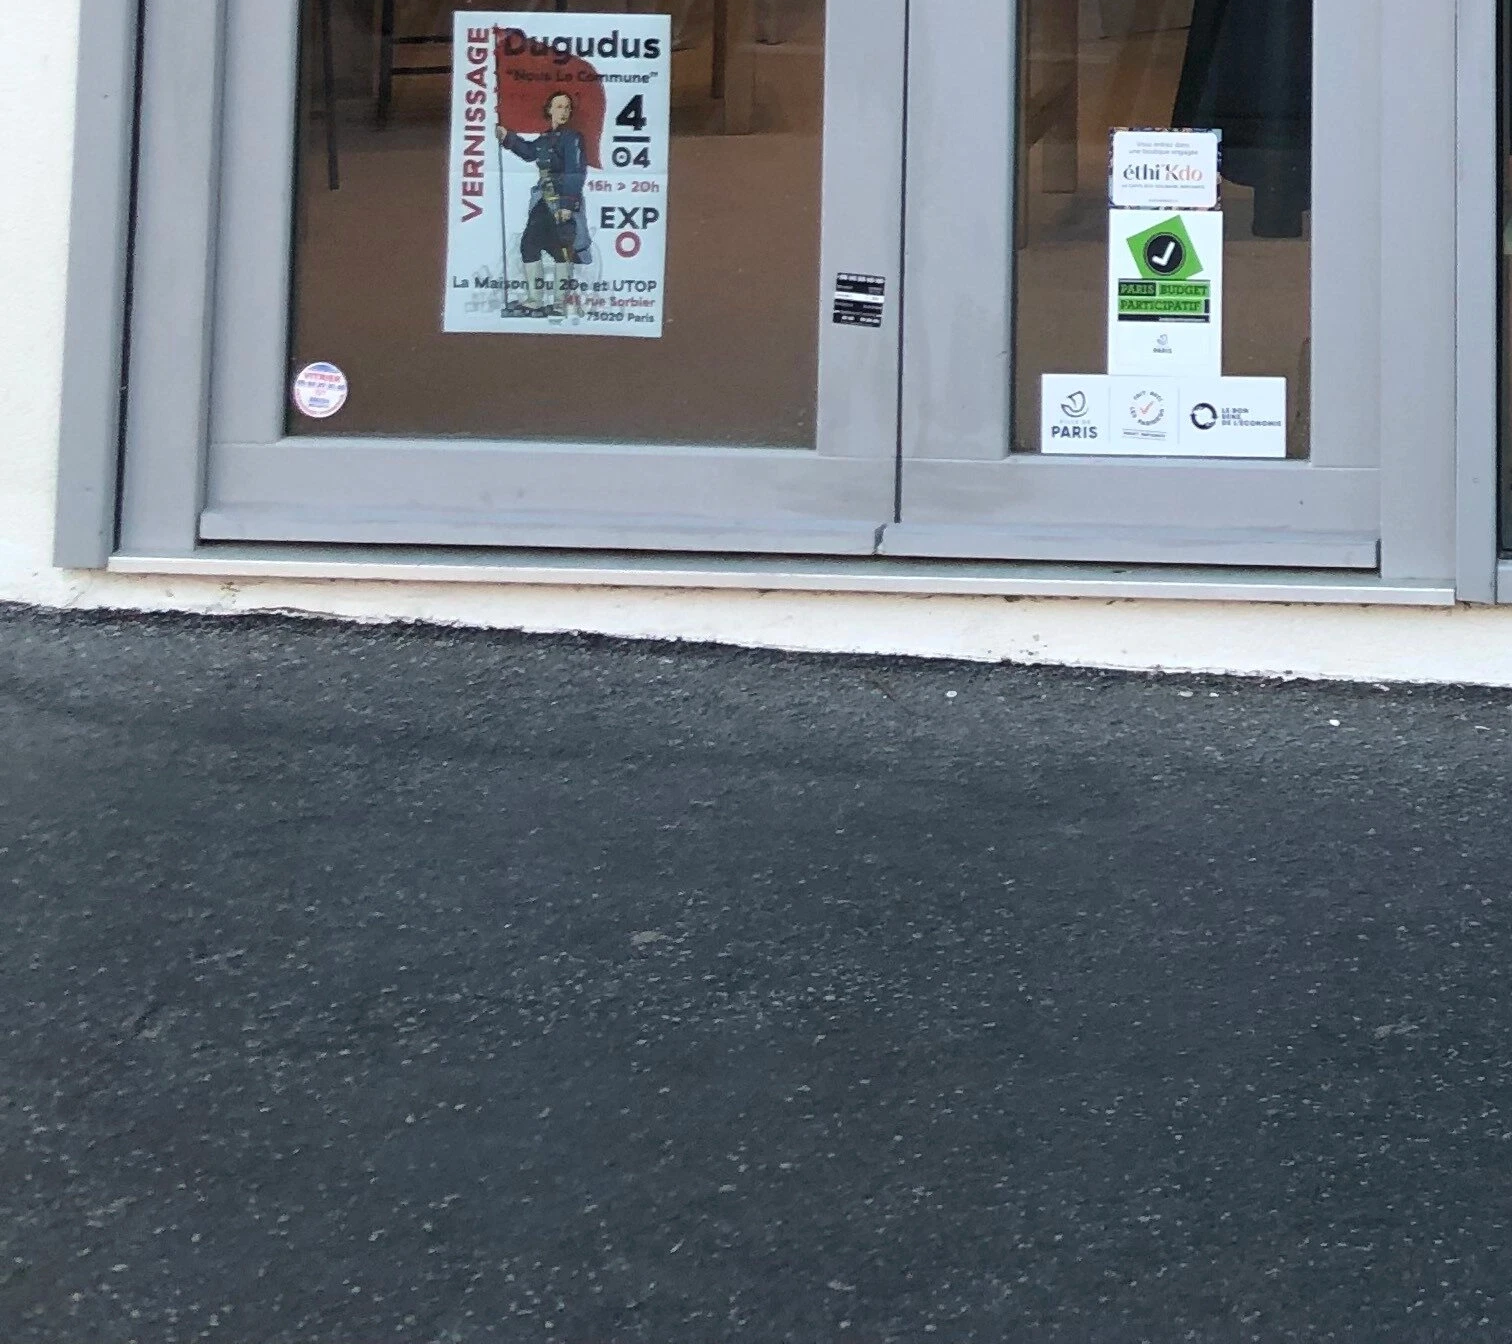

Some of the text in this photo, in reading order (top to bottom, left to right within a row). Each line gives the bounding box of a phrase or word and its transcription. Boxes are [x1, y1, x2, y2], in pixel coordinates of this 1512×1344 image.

[503, 28, 661, 65] Dugudus
[615, 94, 647, 131] 4
[461, 26, 490, 223] VERNISSAGE
[611, 146, 651, 168] 04
[630, 181, 660, 193] 20h
[600, 206, 660, 229] EXP
[453, 277, 469, 289] La
[475, 276, 529, 290] Maison
[534, 278, 554, 290] Du
[592, 280, 608, 291] et
[612, 279, 657, 292] UTOP
[1120, 283, 1208, 296] PARIS BUDGET
[609, 296, 655, 307] Sorbier
[1120, 299, 1201, 311] PARTICIPATIF
[627, 312, 654, 322] Paris
[1051, 425, 1098, 440] PARIS
